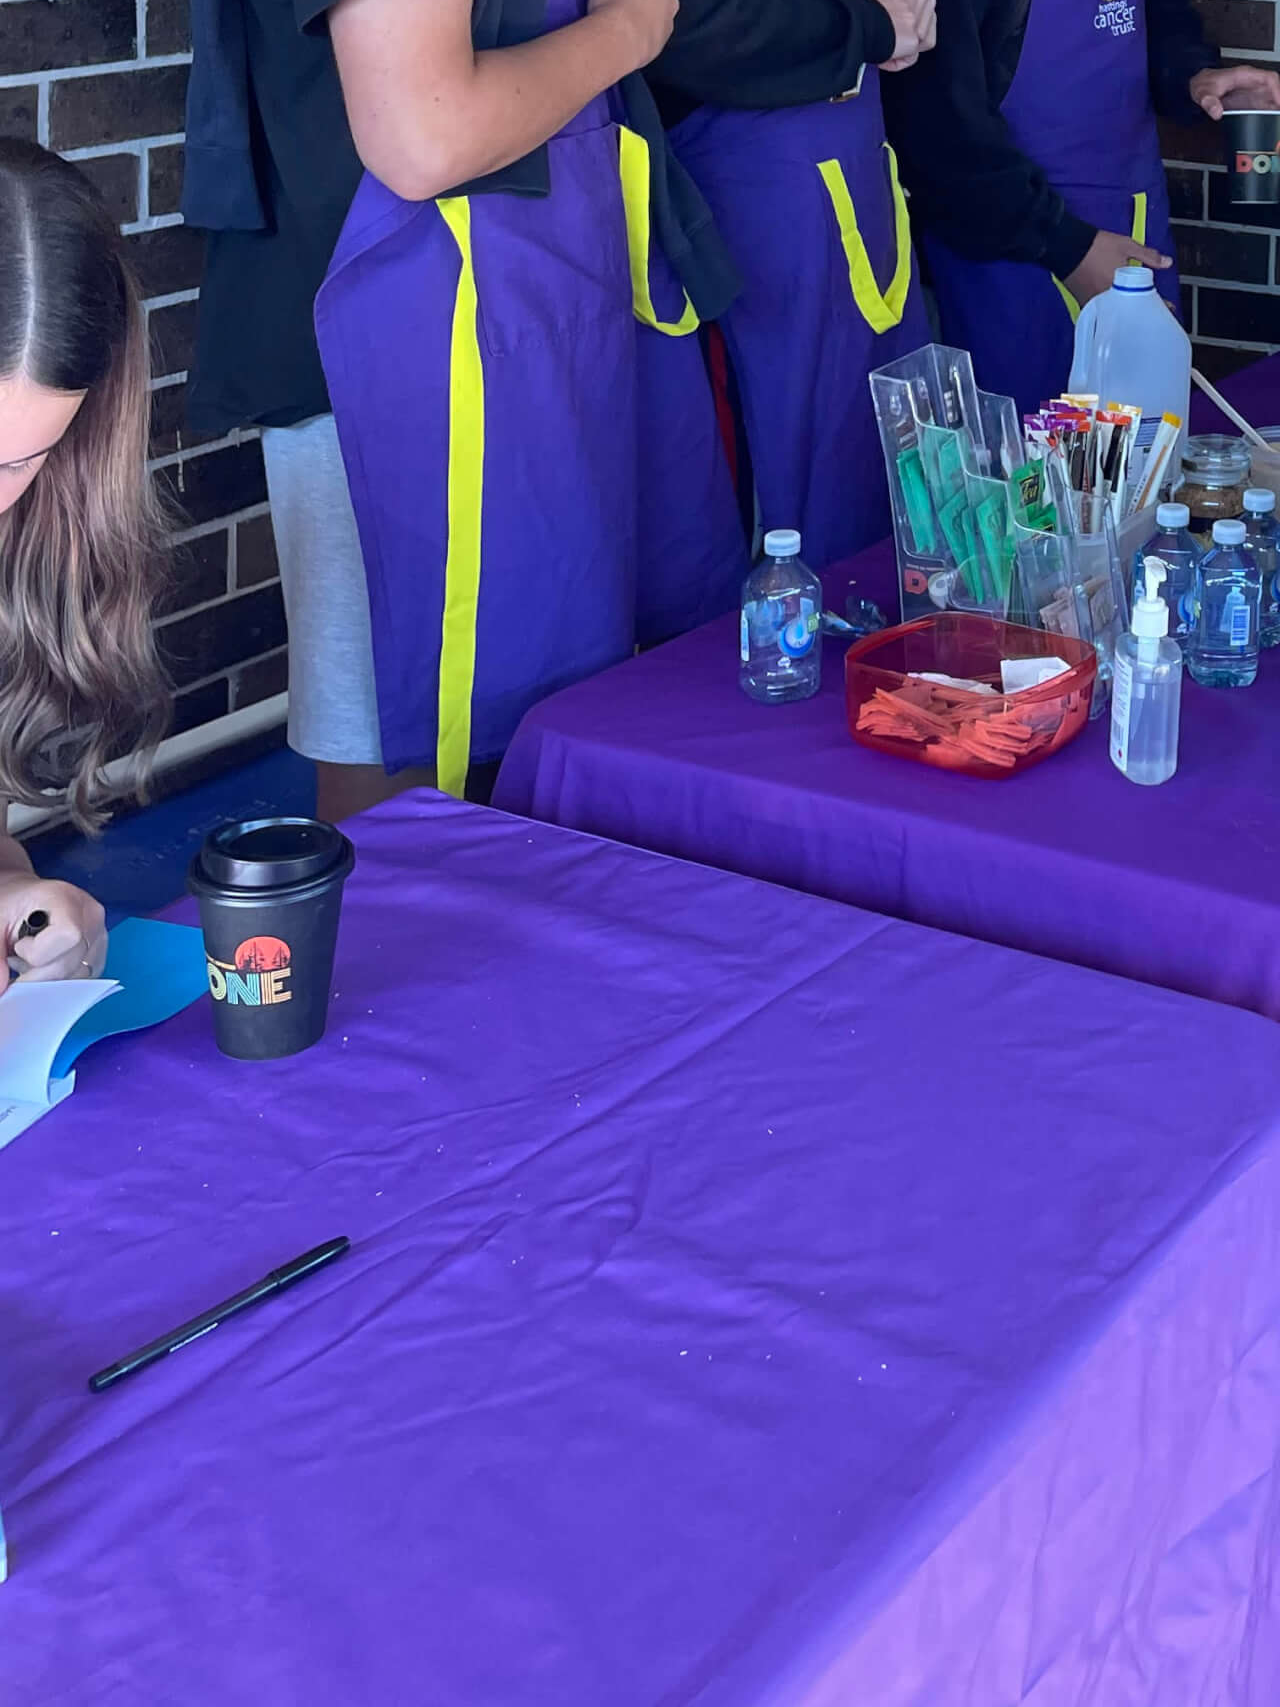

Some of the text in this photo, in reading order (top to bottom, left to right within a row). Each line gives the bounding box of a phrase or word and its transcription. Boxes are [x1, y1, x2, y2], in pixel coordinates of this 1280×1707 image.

[1094, 6, 1136, 29] cancer
[1110, 20, 1137, 36] trust
[206, 963, 292, 1006] ONE
